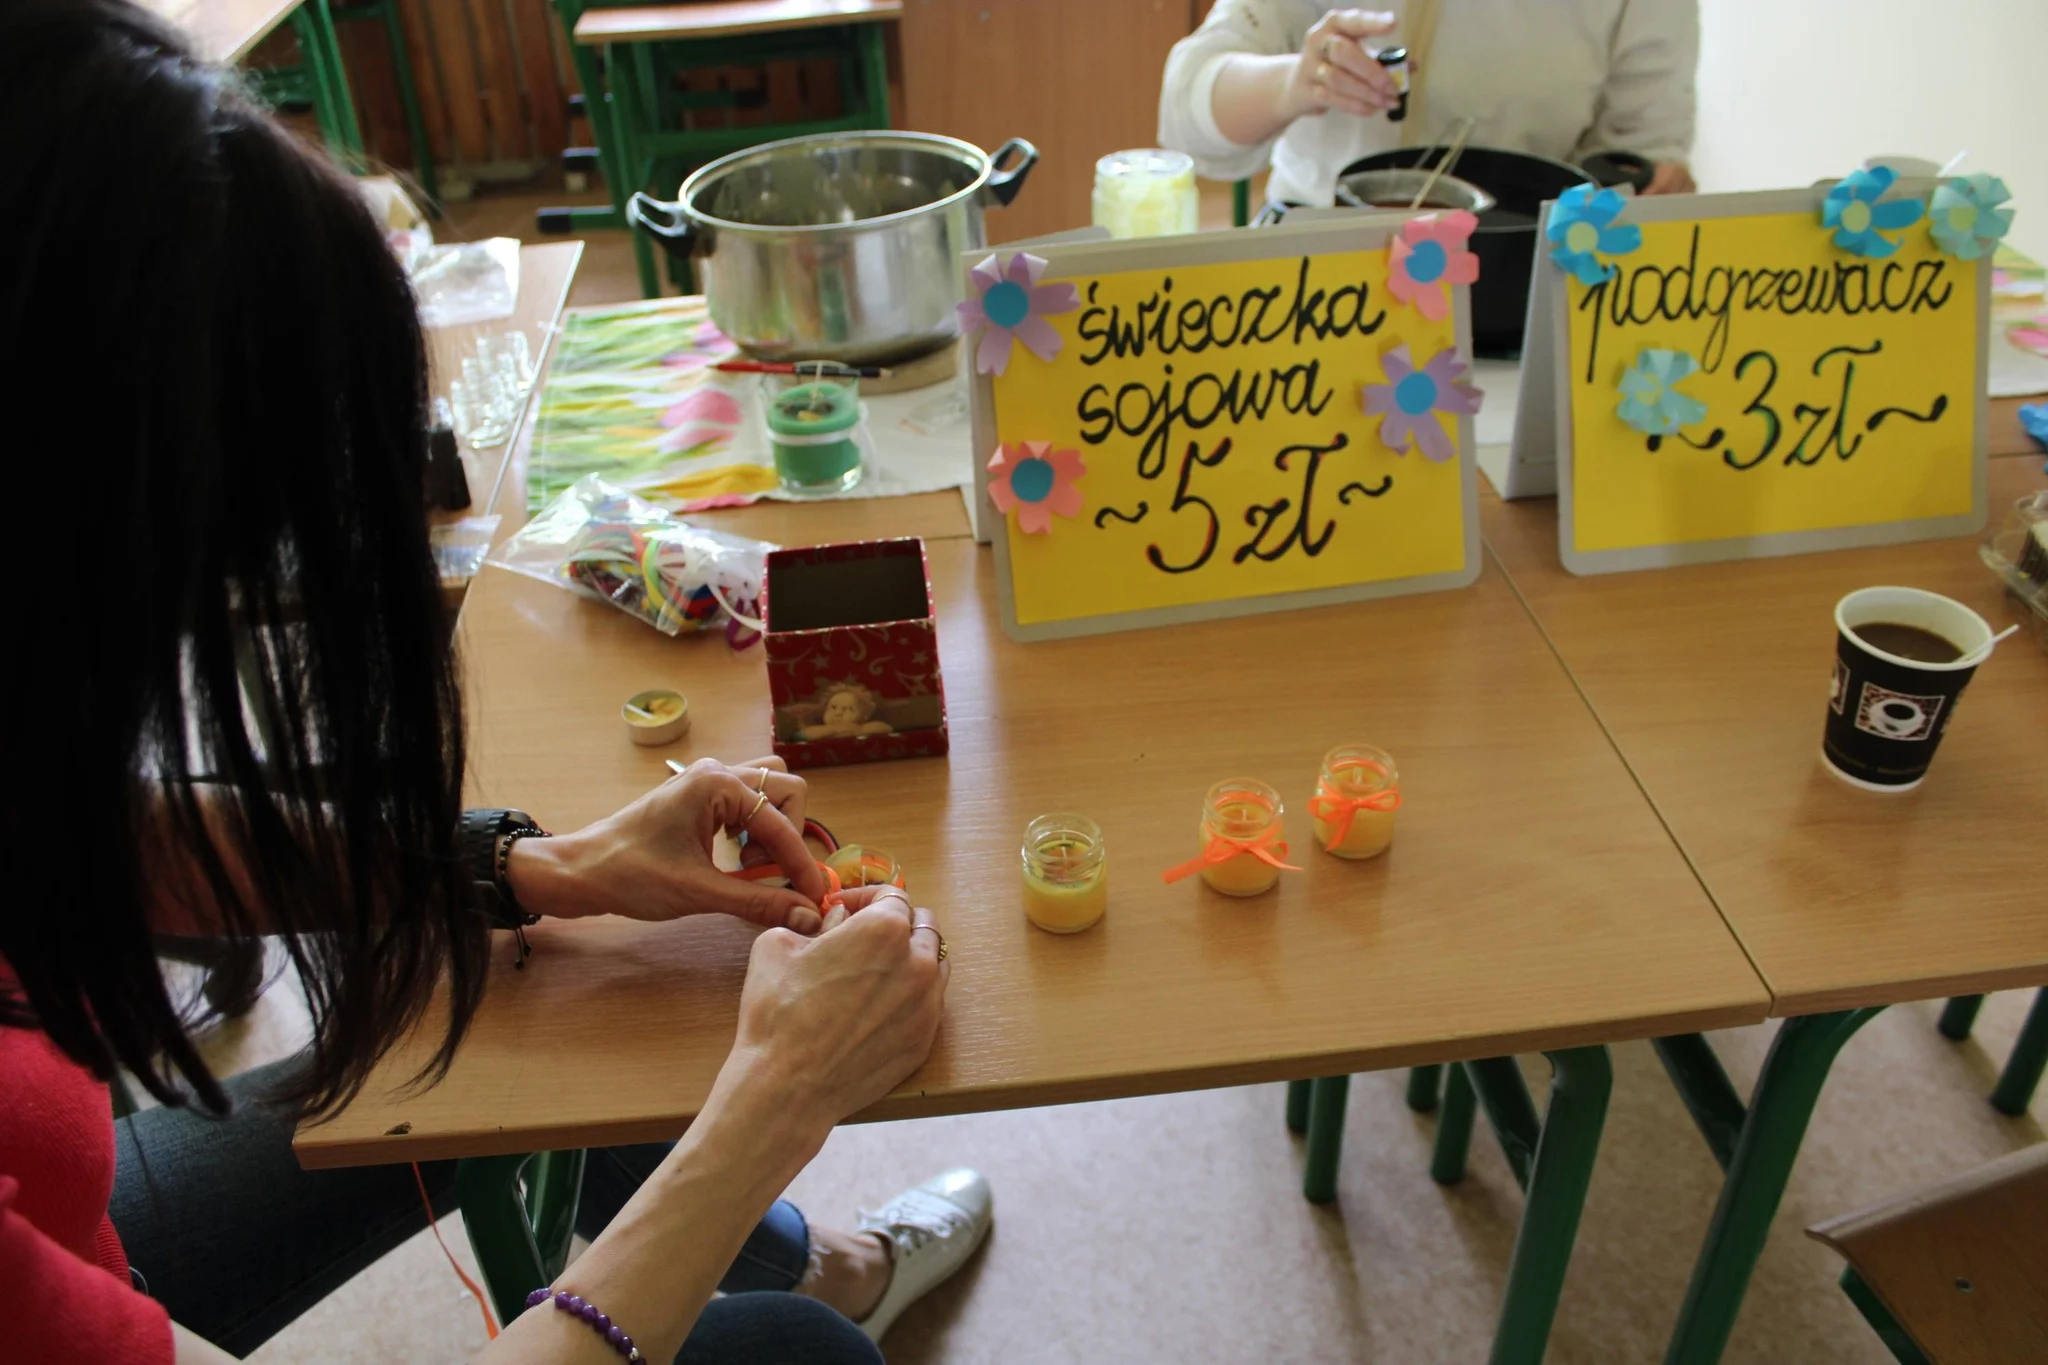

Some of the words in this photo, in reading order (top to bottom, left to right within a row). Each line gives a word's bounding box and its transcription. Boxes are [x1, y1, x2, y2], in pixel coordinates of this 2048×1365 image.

[1078, 255, 1387, 366] świeczka
[1579, 224, 1953, 384] podgrzewacz
[1077, 358, 1334, 480] sojowa
[1723, 350, 1782, 471] 3
[1783, 339, 1883, 467] zł
[1146, 437, 1232, 574] 5
[1232, 432, 1350, 565] zł
